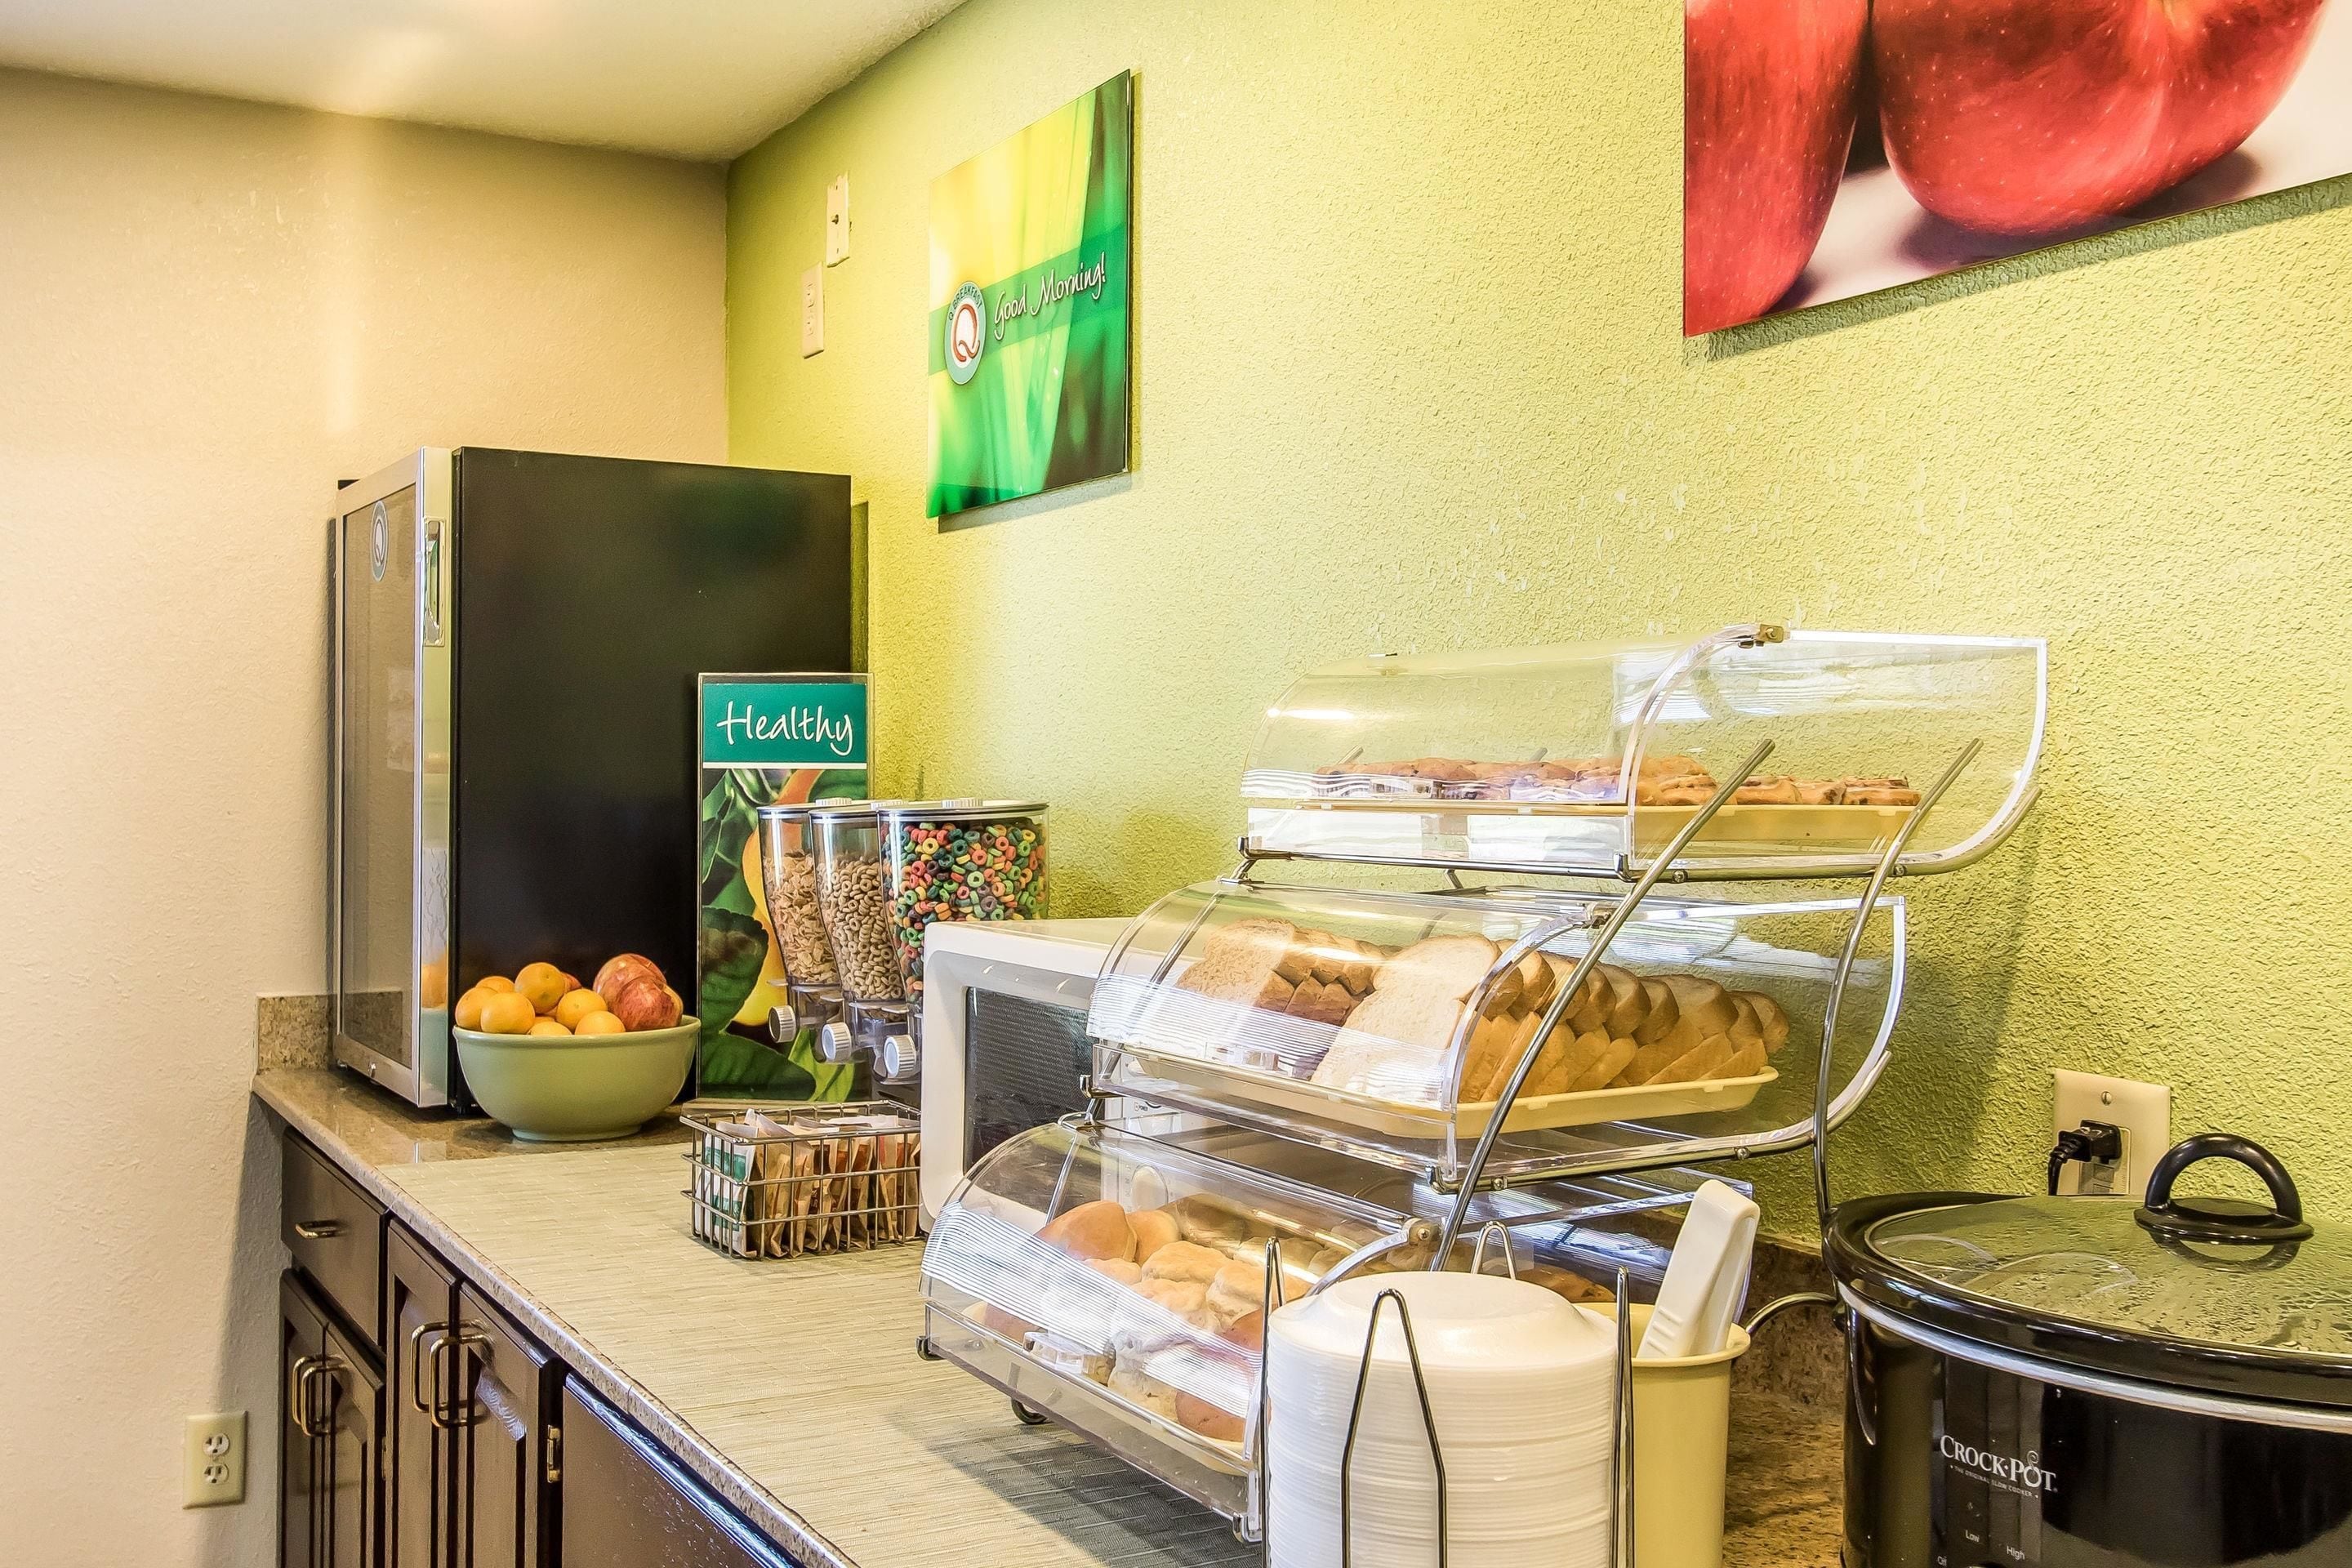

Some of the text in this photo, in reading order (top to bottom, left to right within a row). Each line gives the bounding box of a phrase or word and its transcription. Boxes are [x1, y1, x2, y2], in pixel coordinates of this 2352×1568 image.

[953, 285, 982, 310] BREAKFAST
[993, 251, 1107, 341] Good Morning!
[952, 303, 981, 363] Q
[716, 700, 853, 756] Healthy
[2008, 1485, 2033, 1497] COOKER
[1965, 1529, 1980, 1543] Low
[2006, 1545, 2025, 1561] High
